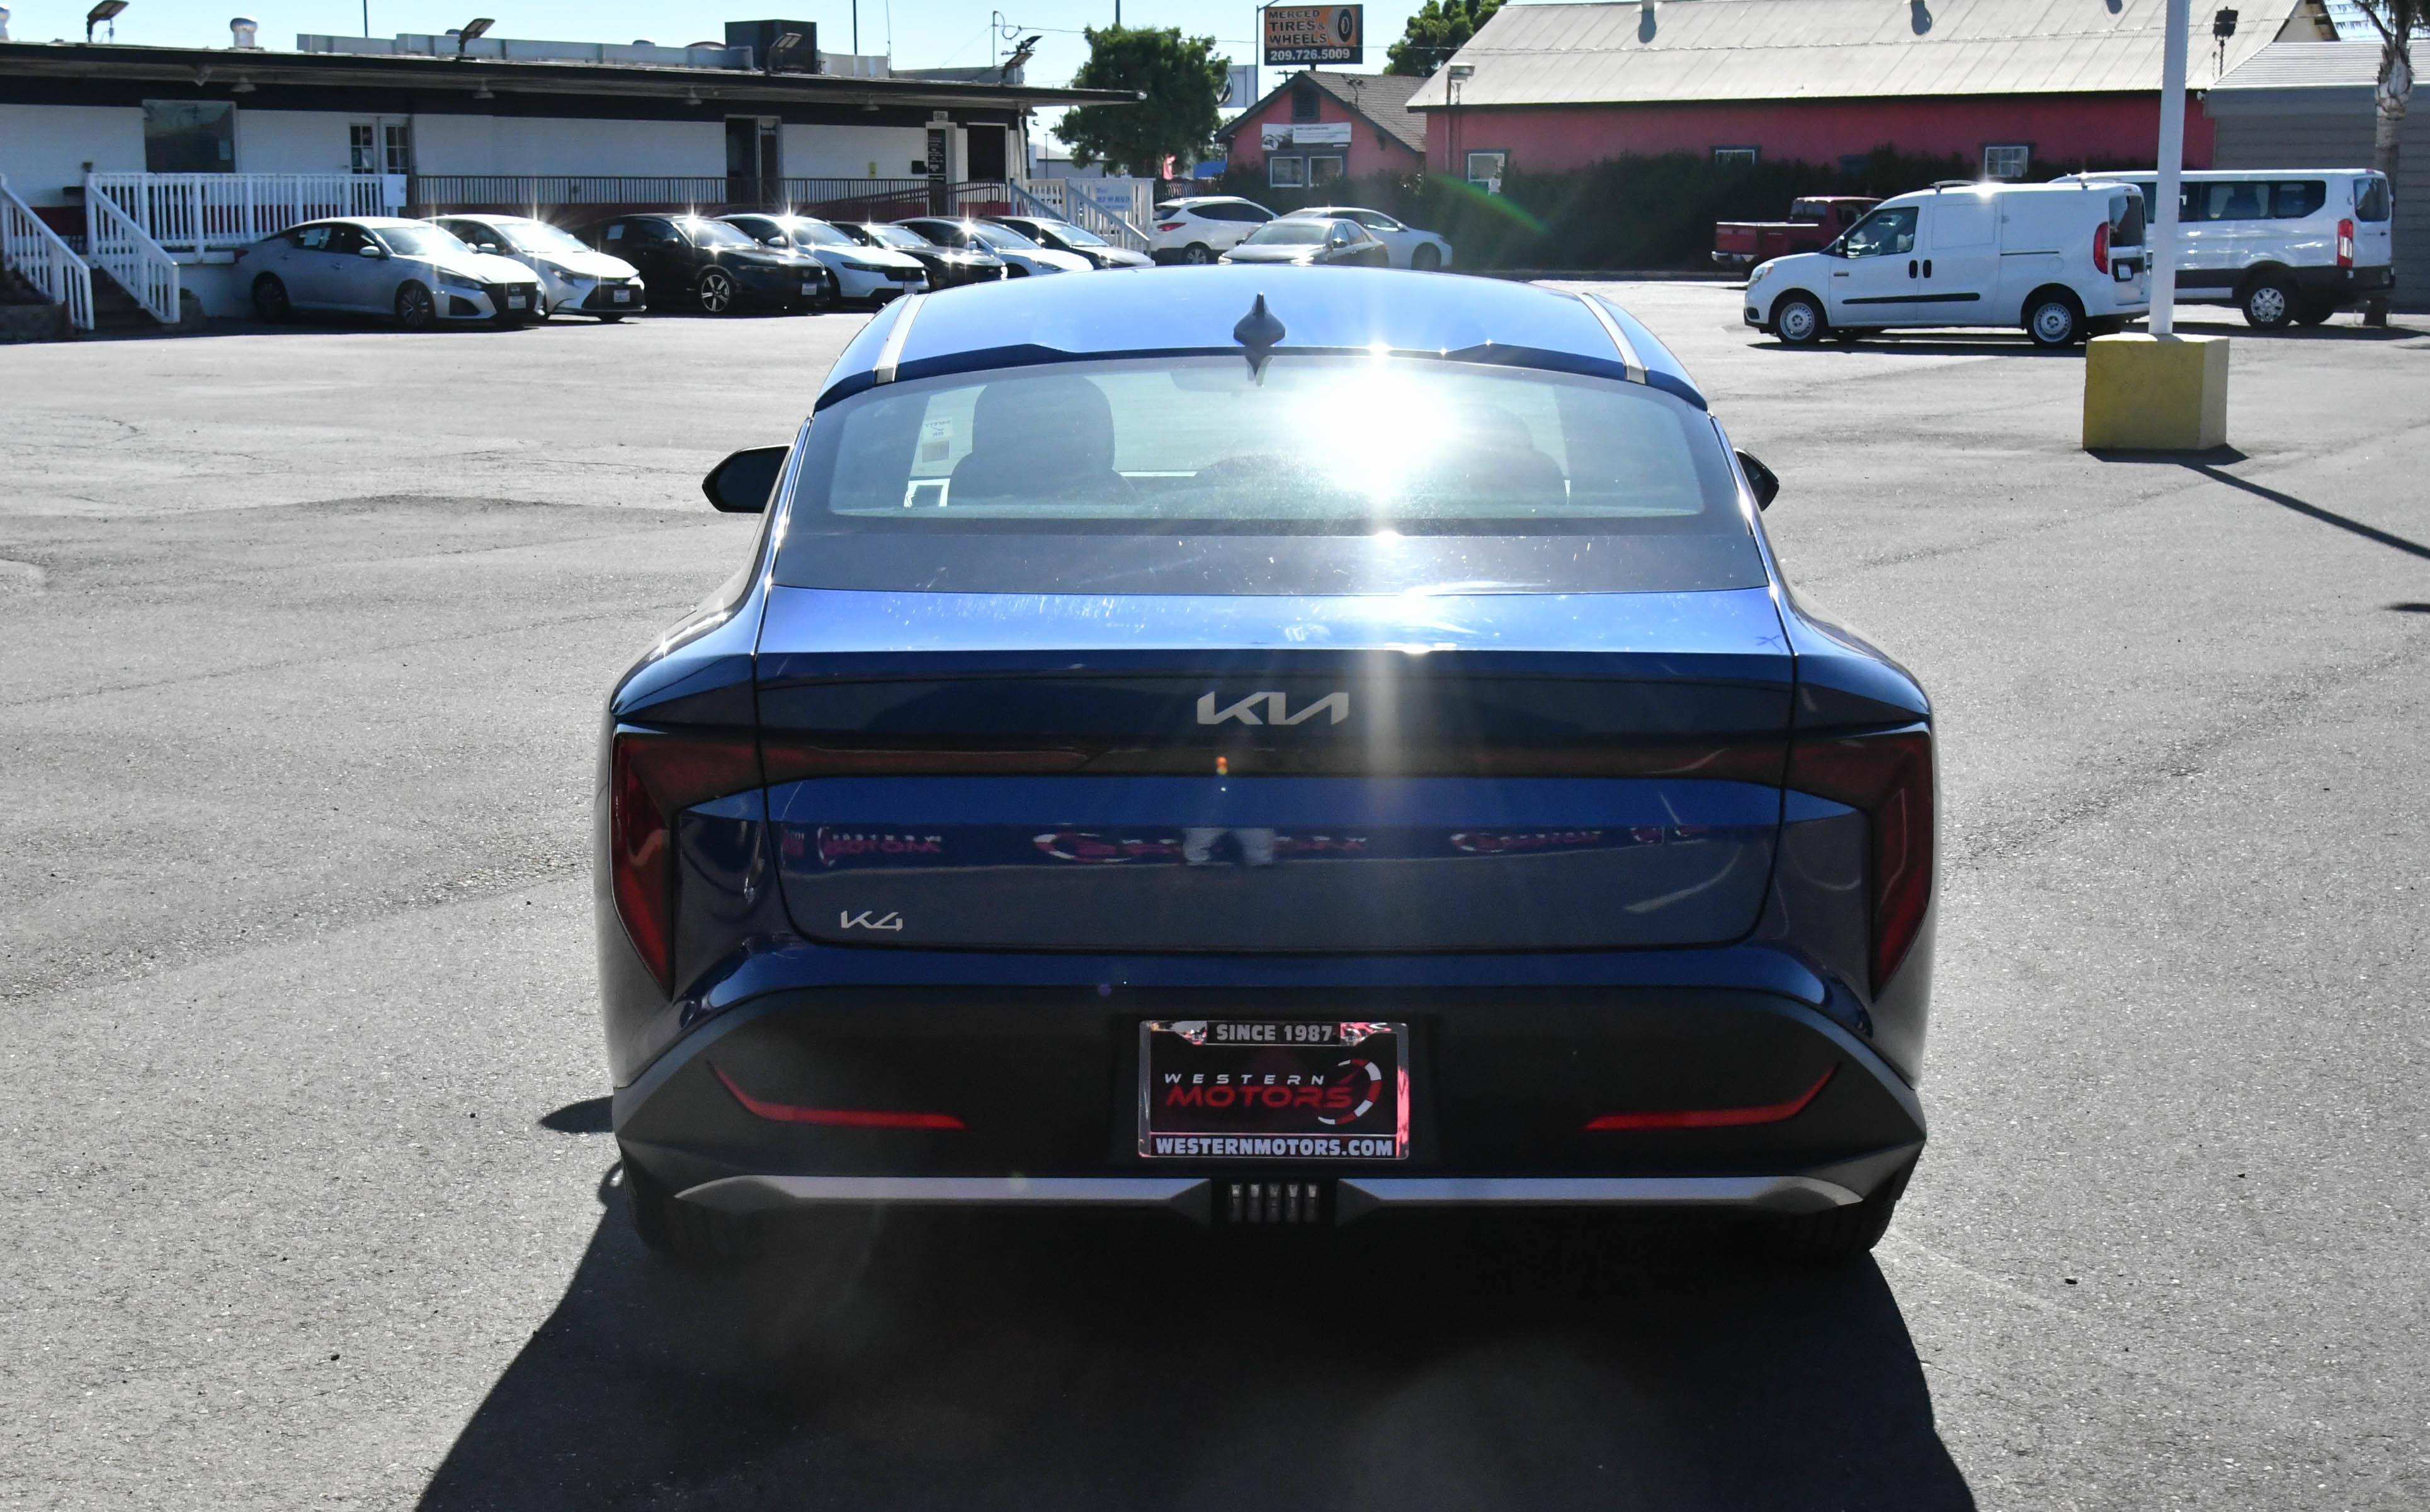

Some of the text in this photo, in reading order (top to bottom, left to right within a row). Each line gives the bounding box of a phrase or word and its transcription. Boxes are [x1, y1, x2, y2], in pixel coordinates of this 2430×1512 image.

[1269, 9, 1320, 19] MERCED
[1269, 21, 1326, 31] TIRES &
[1269, 33, 1327, 45] WHEELS
[1270, 48, 1350, 61] 209.726.5009
[1197, 691, 1349, 725] KIA
[841, 910, 903, 931] K4
[1217, 1024, 1332, 1042] SINCE 1987
[1165, 1073, 1324, 1085] WESTERN
[1166, 1085, 1353, 1108] MOTORS
[1156, 1137, 1393, 1156] WESTERNMOTORS.COM
